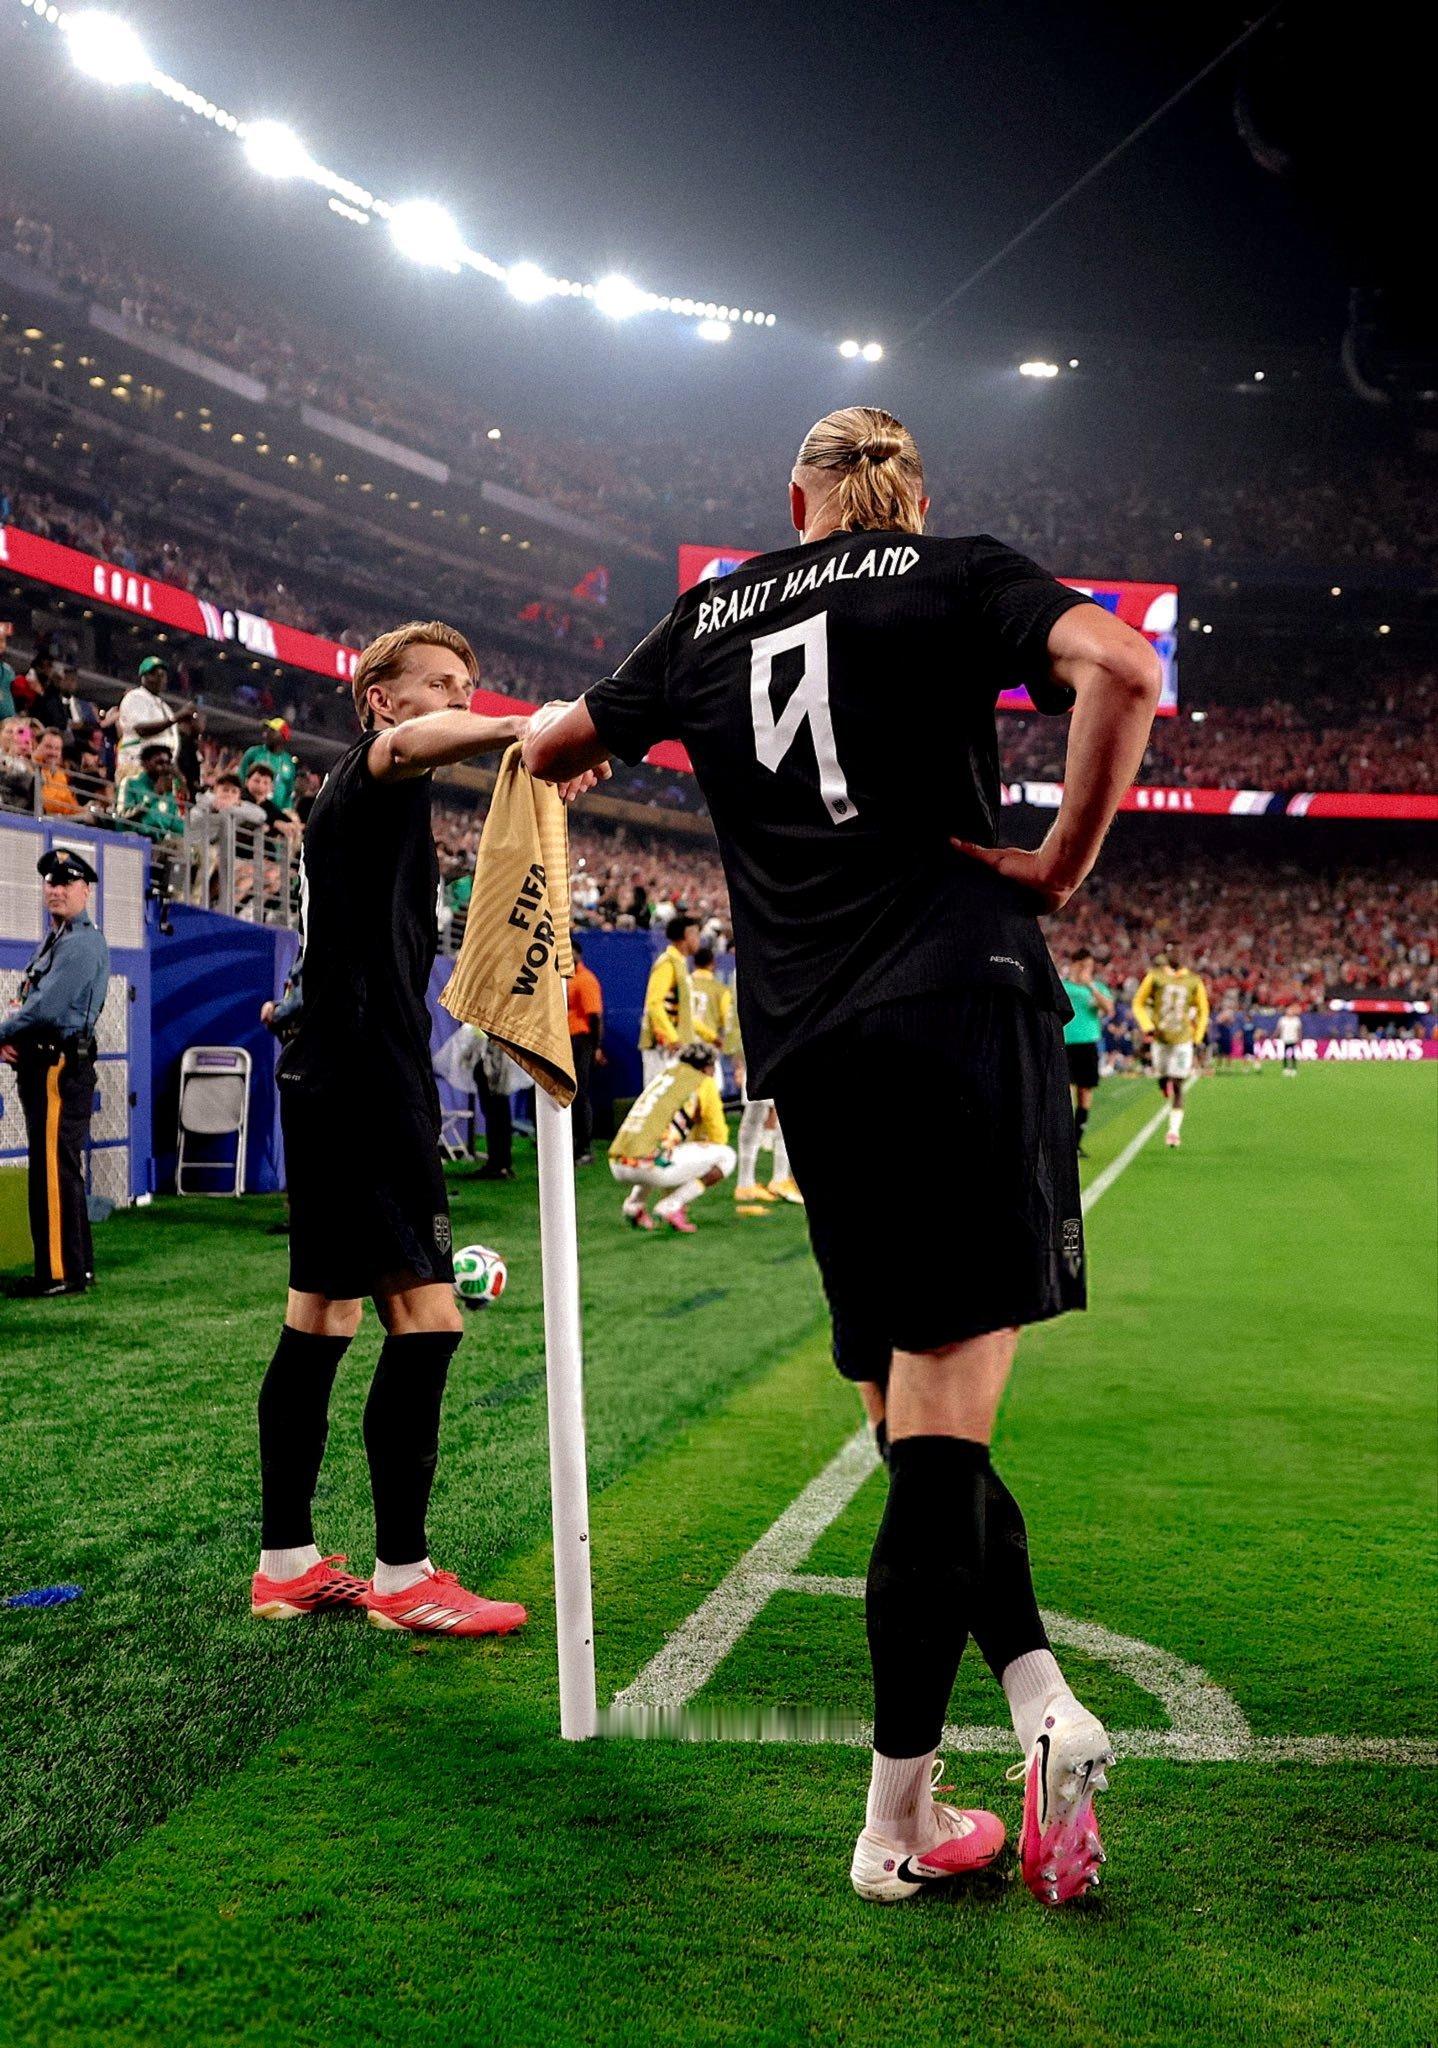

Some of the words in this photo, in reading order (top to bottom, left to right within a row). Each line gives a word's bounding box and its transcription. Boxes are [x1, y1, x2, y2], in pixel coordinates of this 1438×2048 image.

[93, 564, 153, 612] GOAL
[694, 578, 777, 640] BRAUT
[780, 547, 920, 602] HAALAND
[751, 610, 858, 825] 9
[1136, 790, 1194, 810] GOAL
[508, 863, 546, 931] FIFA
[1324, 1038, 1424, 1060] AIRWAYS
